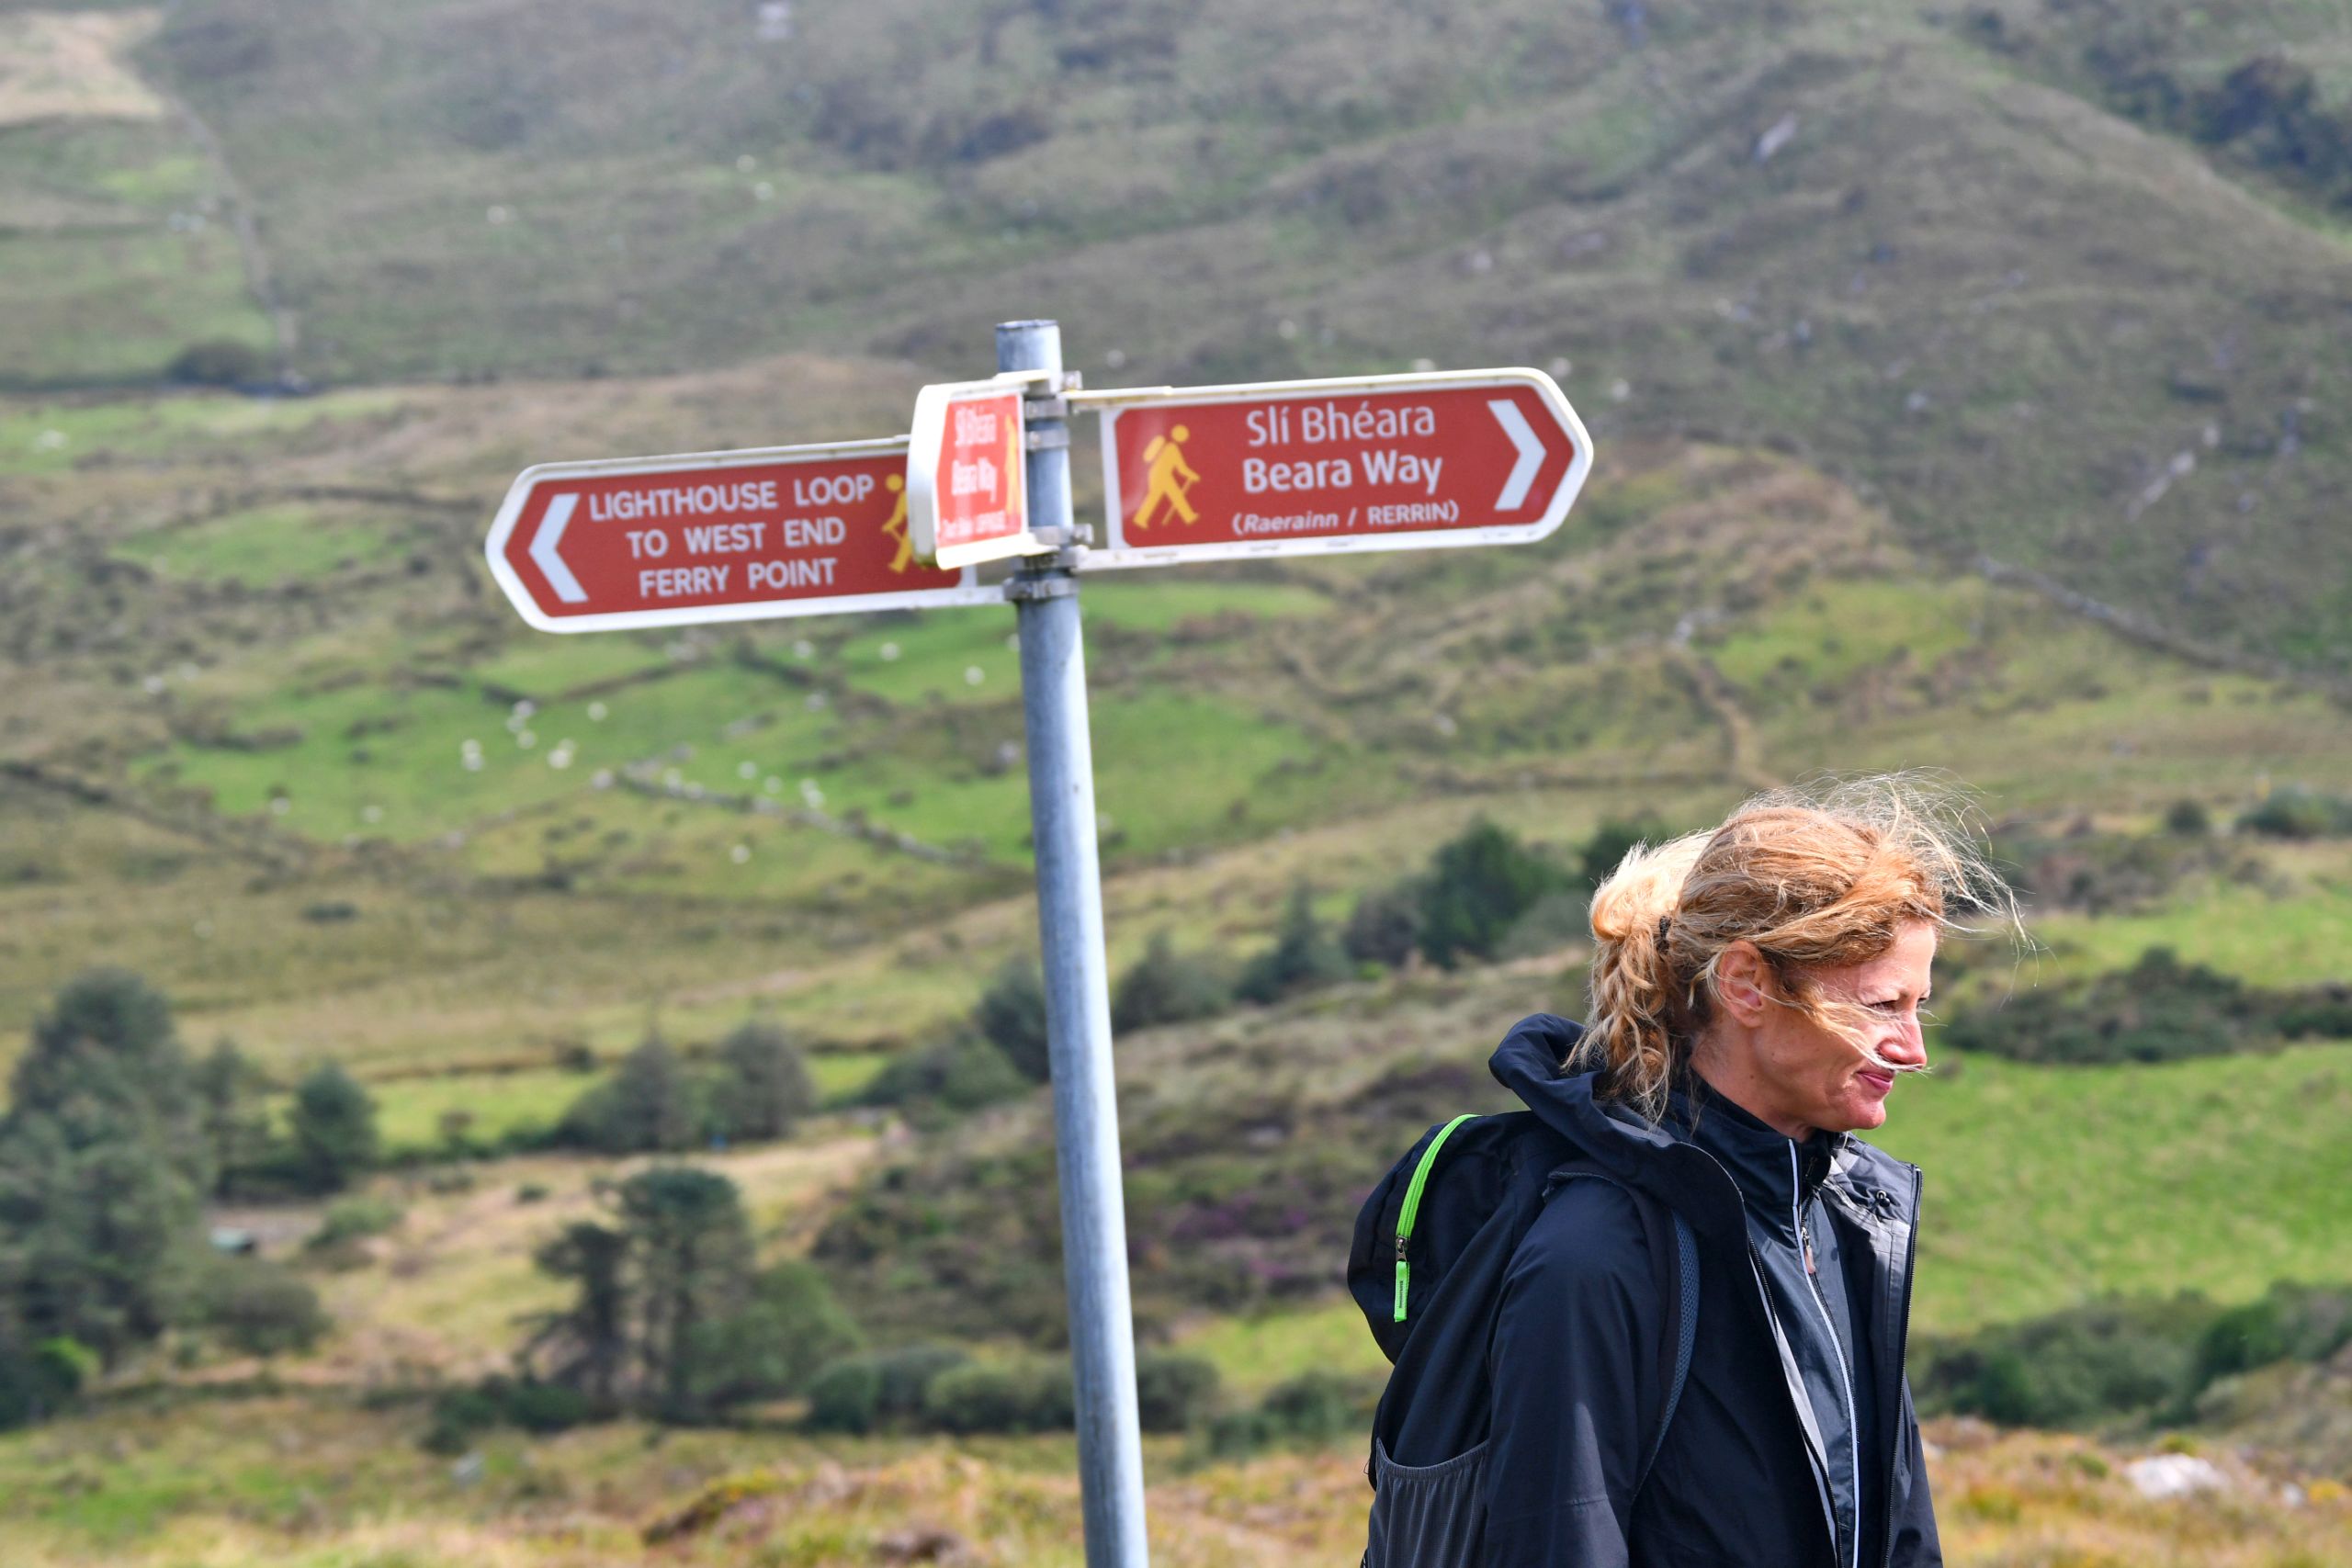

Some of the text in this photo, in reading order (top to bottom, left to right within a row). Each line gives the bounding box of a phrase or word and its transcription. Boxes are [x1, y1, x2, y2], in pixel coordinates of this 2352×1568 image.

[1246, 400, 1436, 446] Slí Bhéara
[1242, 449, 1442, 495] Beara Way
[589, 473, 875, 522] LIGHTHOUSE LOOP
[1231, 509, 1339, 536] (Raerainn
[1366, 500, 1460, 525] RERRIN)
[625, 516, 846, 559] TO WEST END
[639, 557, 838, 598] FERRY POINT
